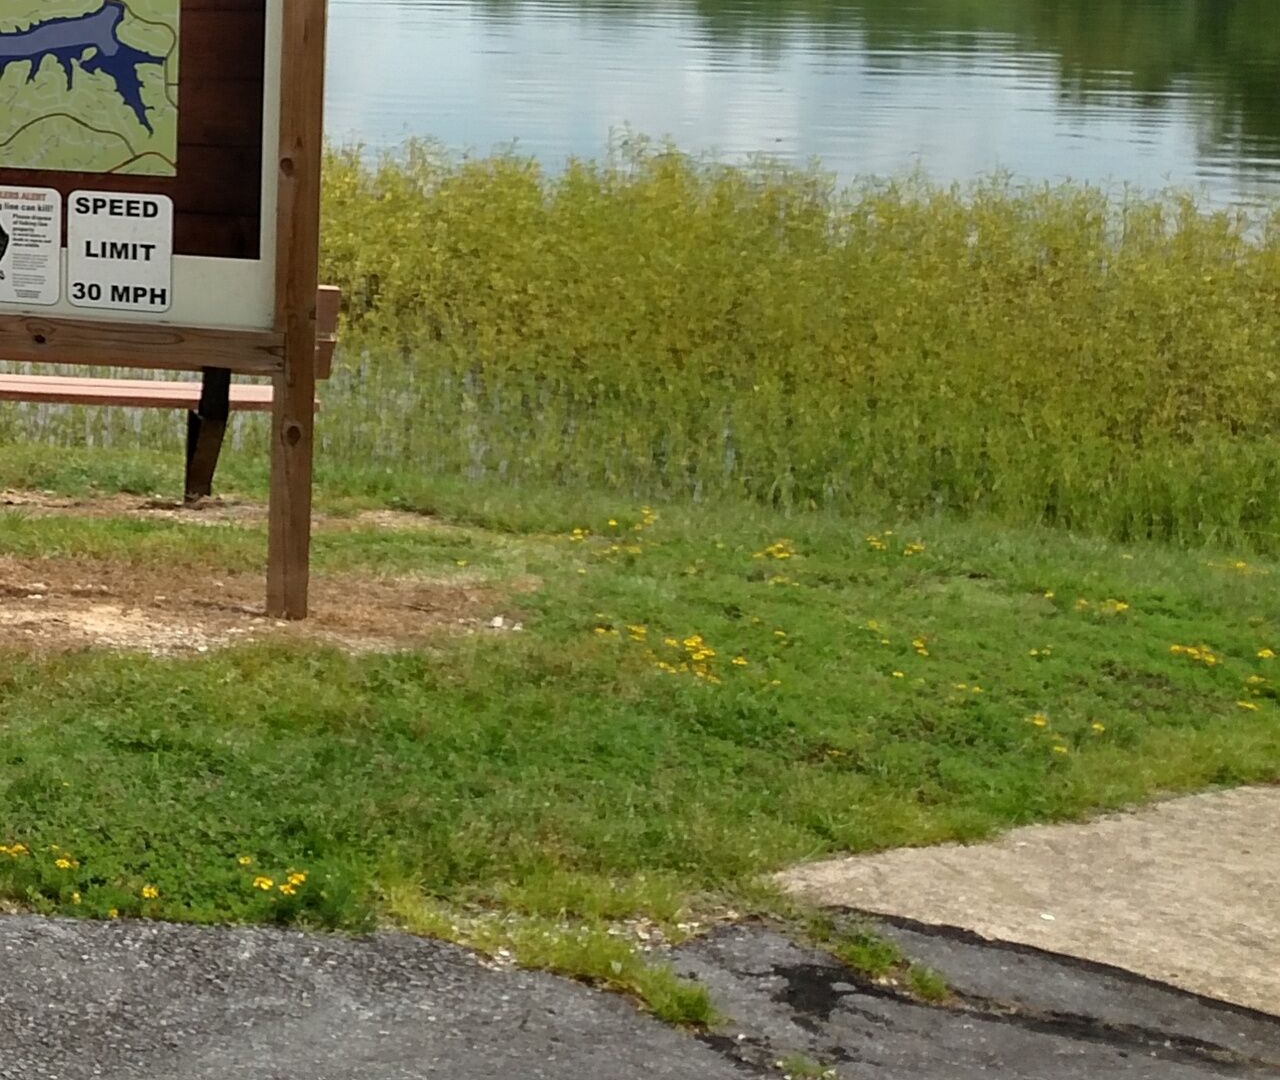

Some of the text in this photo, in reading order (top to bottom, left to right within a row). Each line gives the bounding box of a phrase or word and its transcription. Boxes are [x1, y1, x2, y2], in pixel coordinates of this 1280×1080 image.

[4, 202, 19, 210] line
[38, 204, 53, 212] kill!
[76, 198, 158, 218] SPEED
[86, 241, 156, 261] LIMIT
[73, 283, 166, 305] 30 MPH
